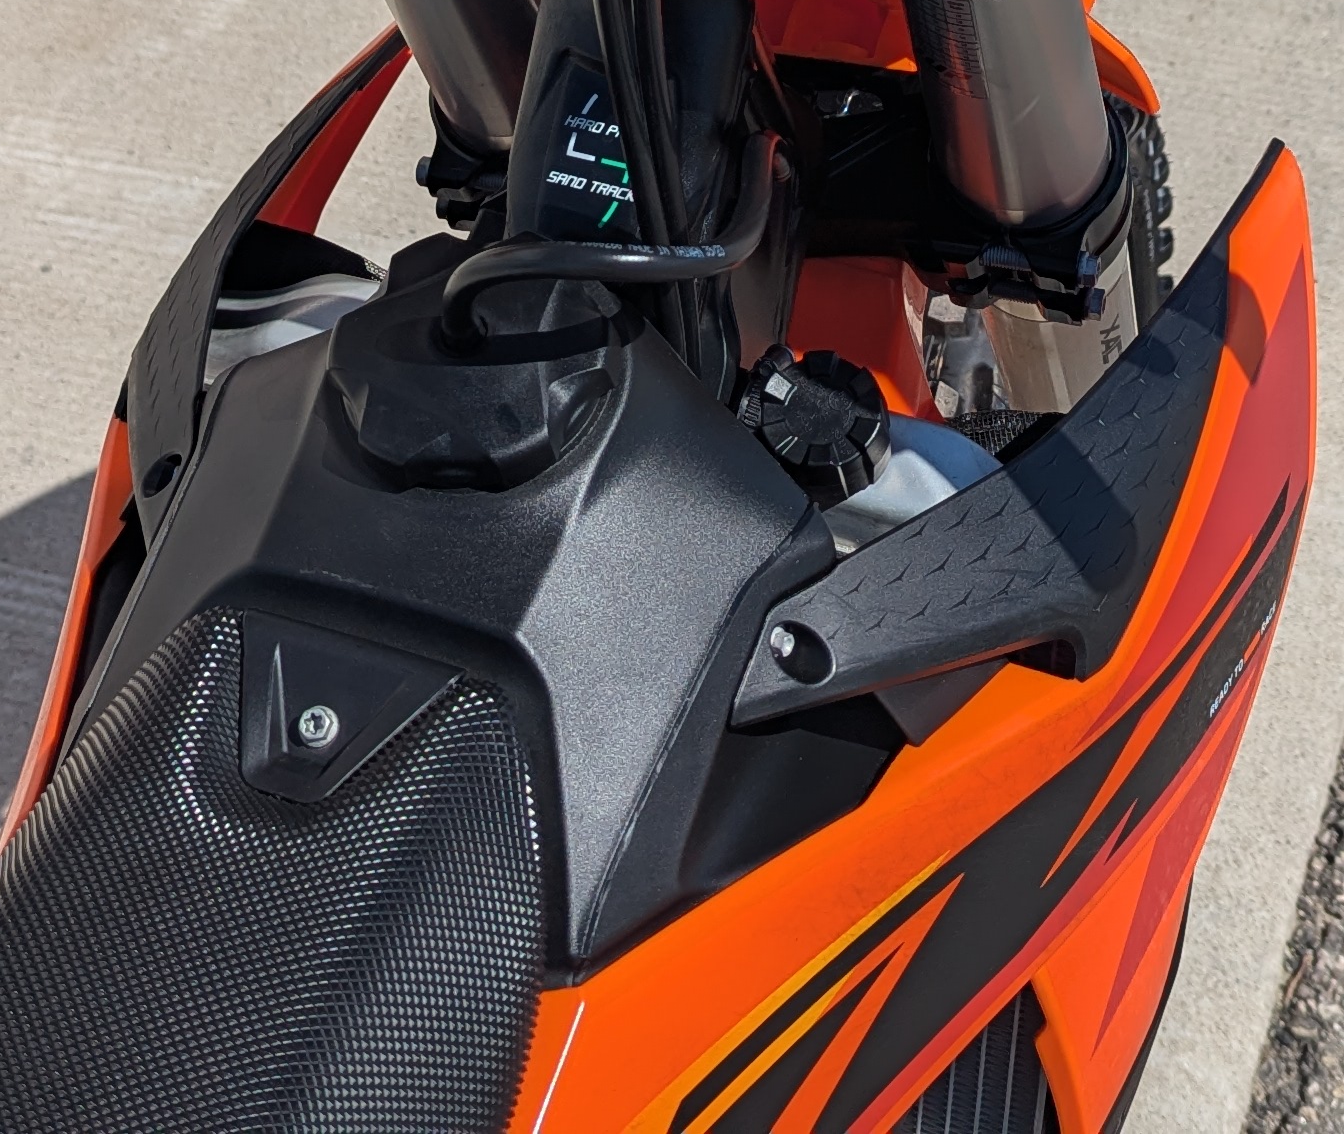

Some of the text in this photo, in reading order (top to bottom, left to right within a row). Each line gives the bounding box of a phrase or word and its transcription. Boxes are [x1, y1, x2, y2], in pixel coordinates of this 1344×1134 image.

[564, 115, 605, 134] HARD
[546, 170, 634, 202] SAND TRACK
[1209, 673, 1233, 718] READY
[1234, 658, 1244, 677] TO
